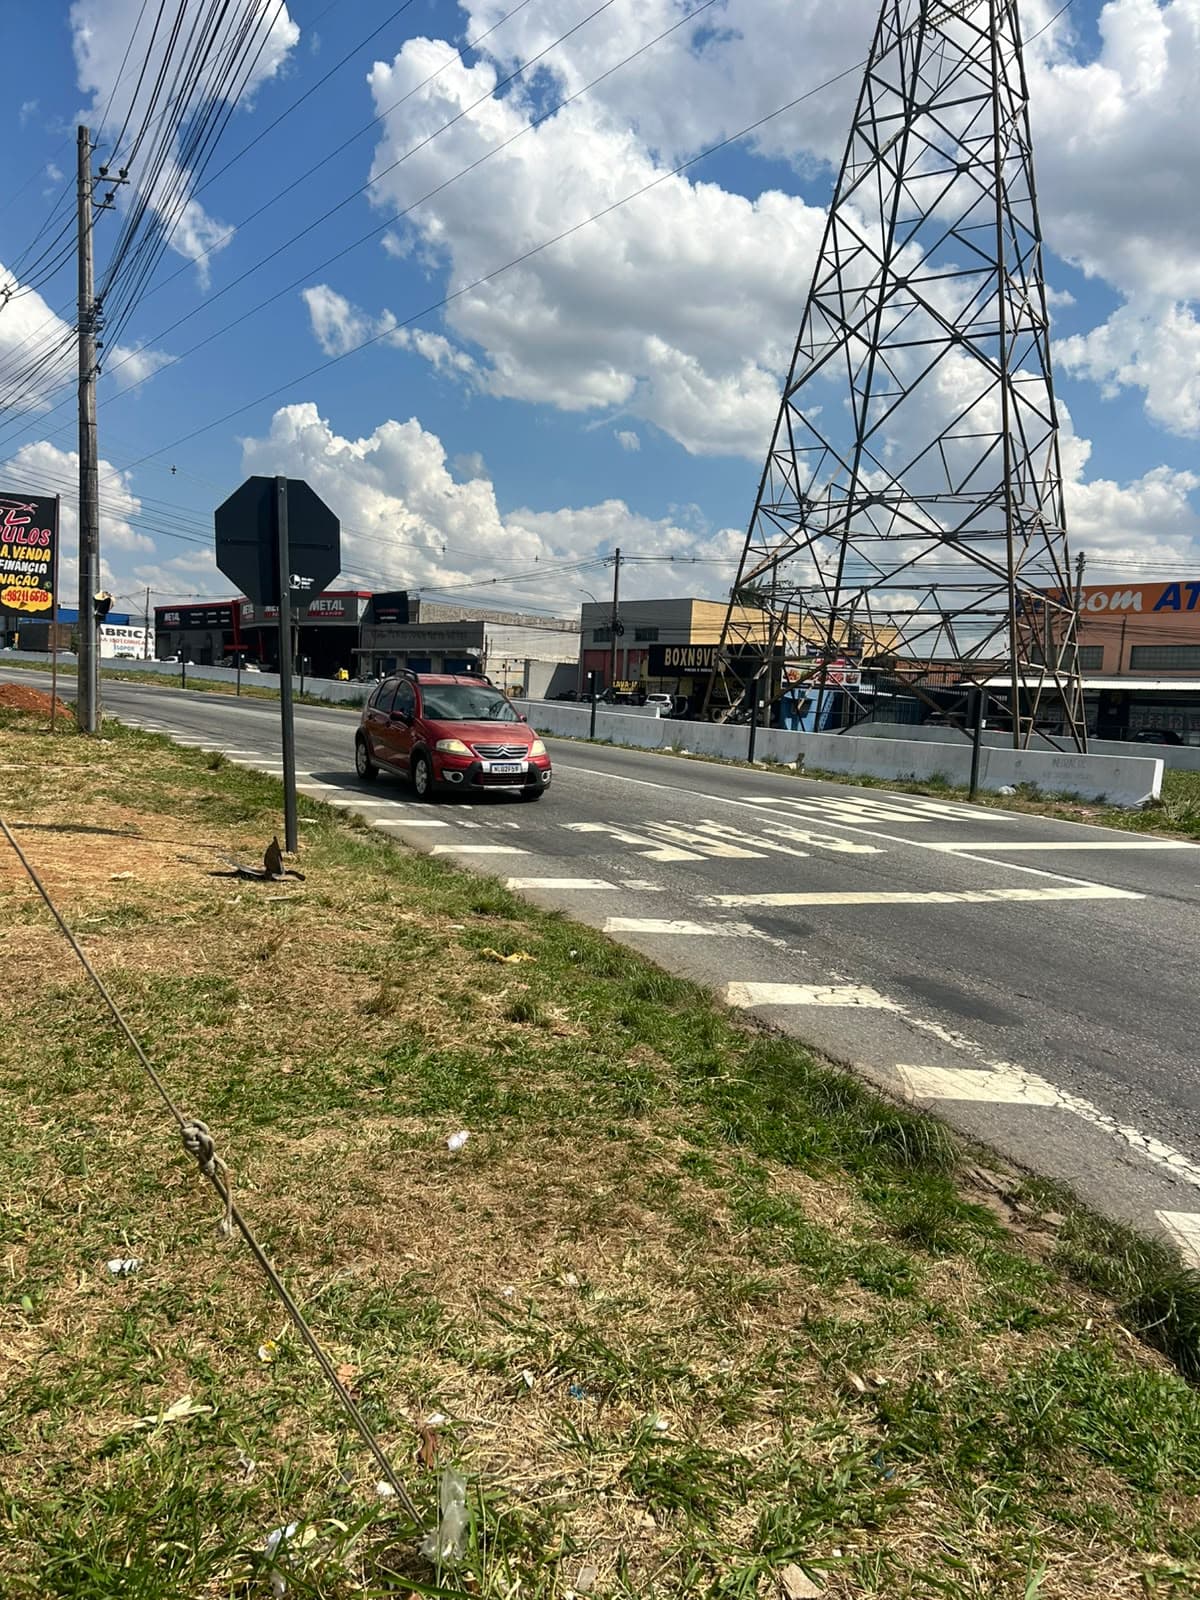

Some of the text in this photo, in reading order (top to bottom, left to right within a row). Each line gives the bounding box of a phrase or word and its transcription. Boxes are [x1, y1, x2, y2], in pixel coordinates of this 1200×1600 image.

[0, 525, 52, 546] ULOS
[12, 545, 51, 562] VENDA
[309, 600, 344, 611] METAL
[738, 796, 1019, 823] PARE
[555, 818, 888, 861] PARE
